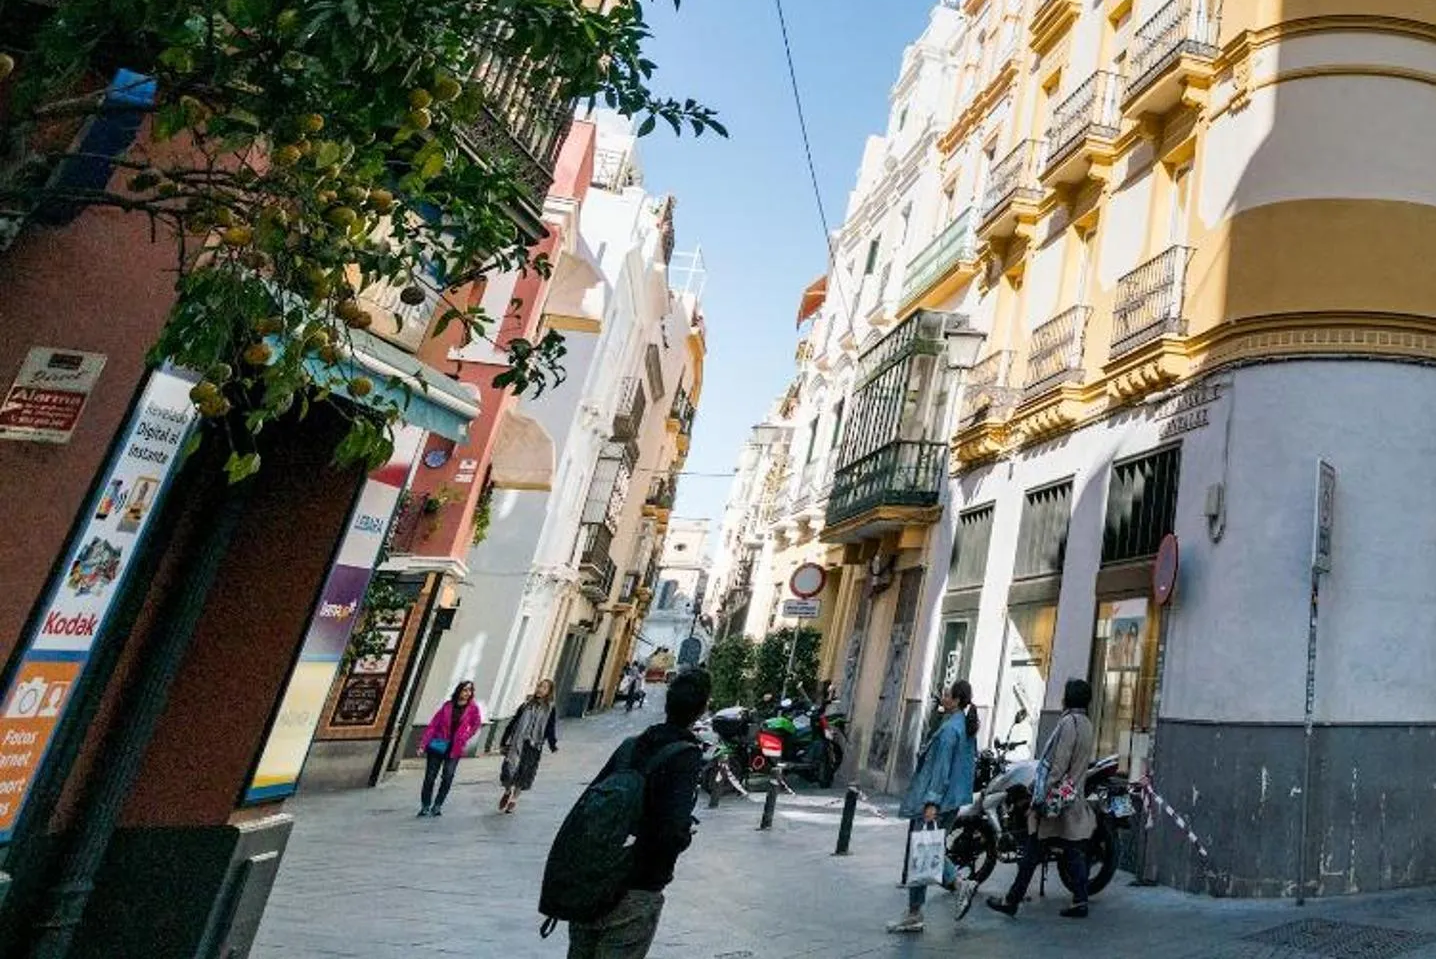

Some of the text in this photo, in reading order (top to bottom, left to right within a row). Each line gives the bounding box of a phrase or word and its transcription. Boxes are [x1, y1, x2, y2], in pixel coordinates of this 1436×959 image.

[10, 389, 82, 404] Alarma
[137, 421, 171, 443] Digital
[42, 610, 98, 636] Kodak
[2, 728, 39, 746] Fotos
